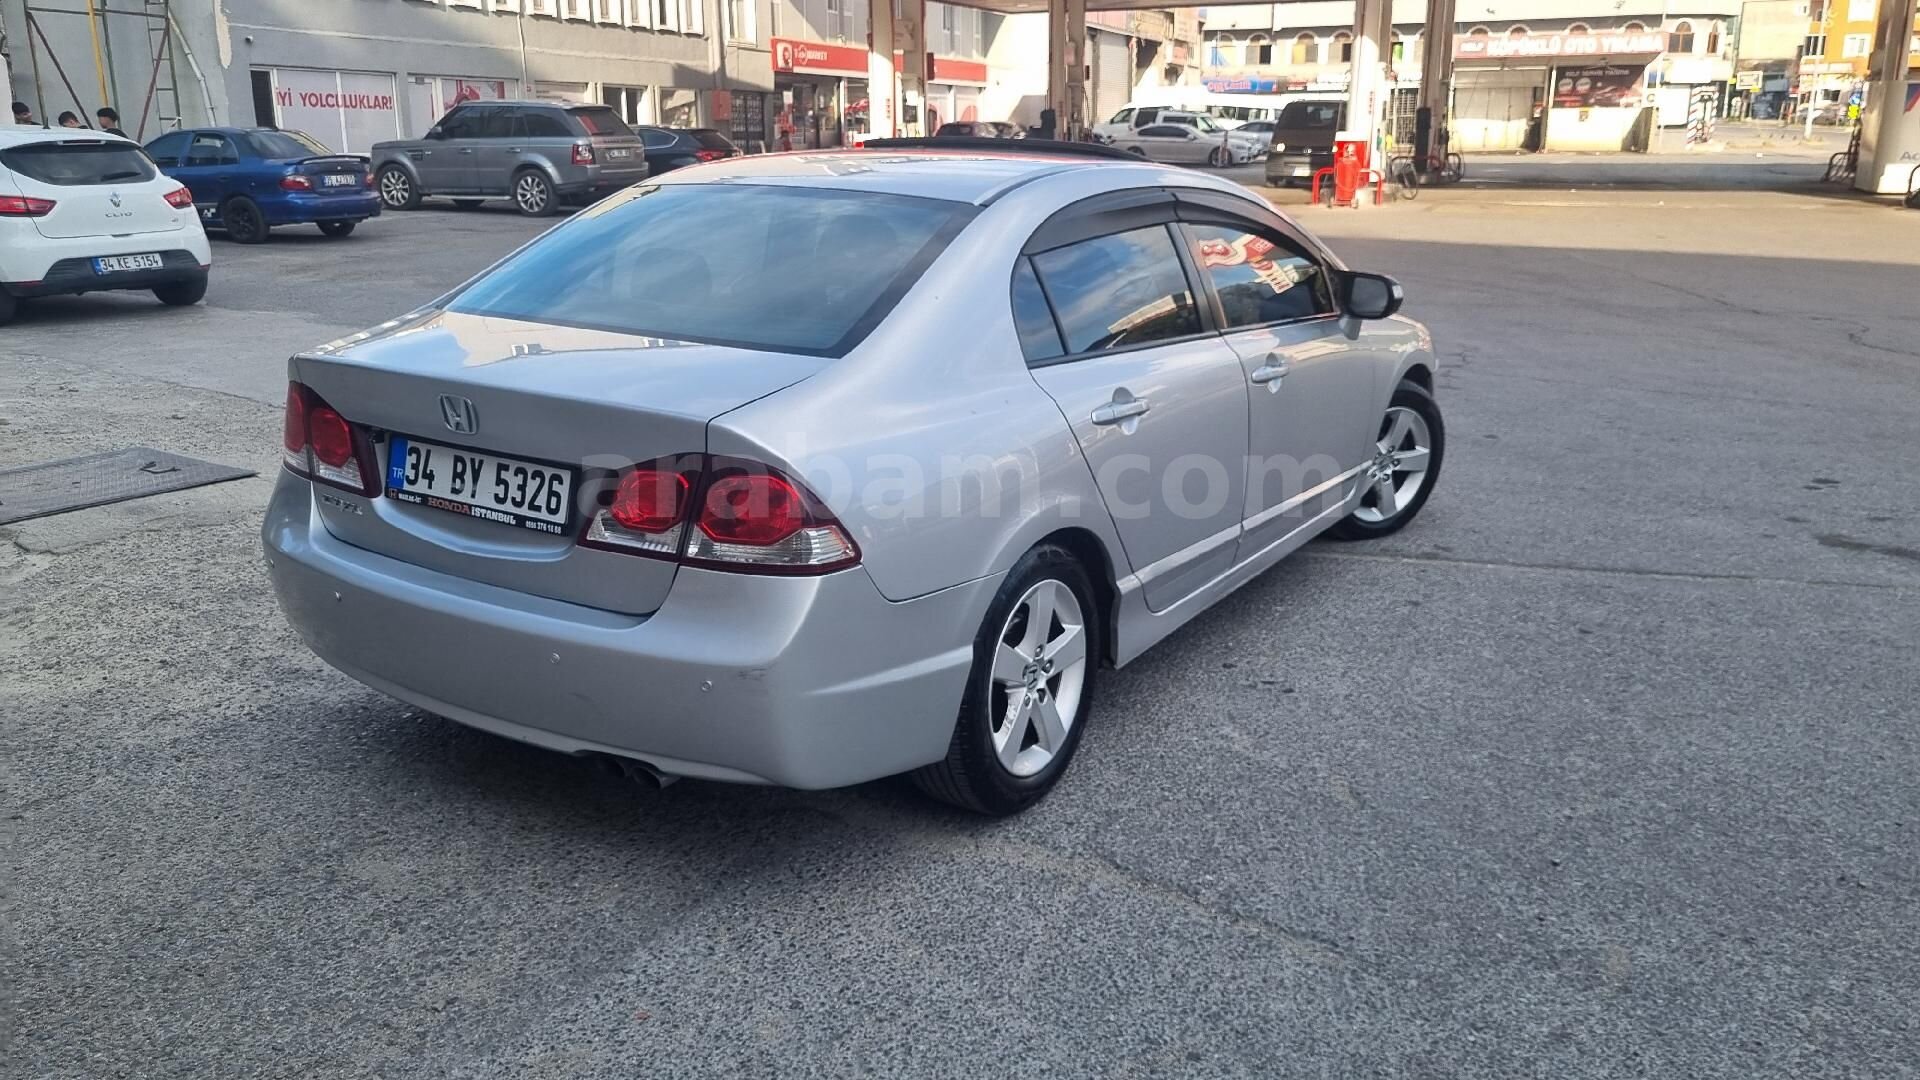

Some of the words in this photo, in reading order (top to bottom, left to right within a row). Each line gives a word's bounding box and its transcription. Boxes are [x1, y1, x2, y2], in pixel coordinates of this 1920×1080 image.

[1563, 37, 1597, 53] OTO
[299, 92, 393, 111] YOLCULUKLAR!
[100, 256, 115, 272] 34
[135, 254, 160, 268] 5154
[392, 467, 404, 480] TR
[404, 446, 436, 490] 34
[450, 454, 484, 499] BY
[493, 462, 564, 516] 5326
[427, 497, 470, 516] HONDA
[471, 506, 516, 525] İSTANBUL
